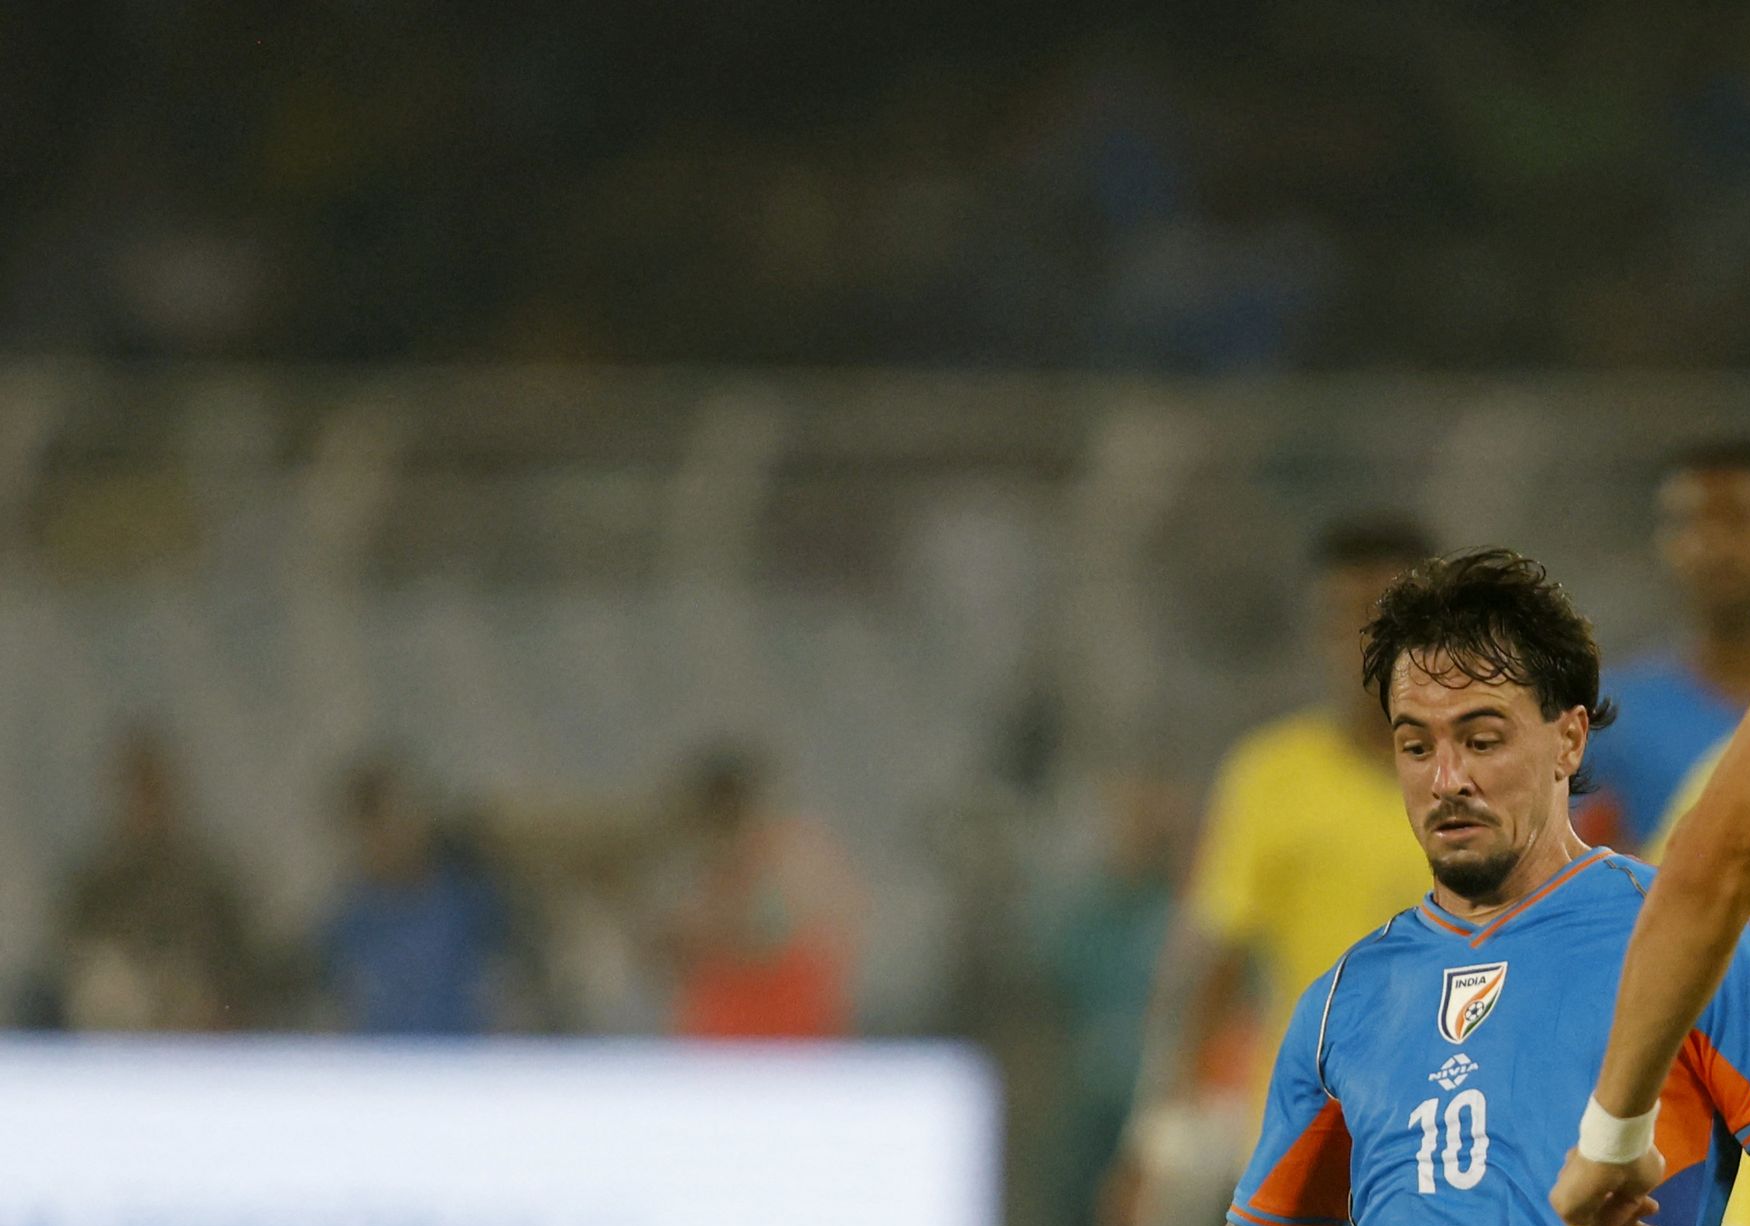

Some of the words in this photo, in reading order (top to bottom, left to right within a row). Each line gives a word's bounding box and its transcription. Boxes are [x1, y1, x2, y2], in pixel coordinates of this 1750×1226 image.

[1454, 975, 1487, 990] INDIA
[1428, 1062, 1480, 1083] NIVIA
[1408, 1088, 1490, 1195] 10
